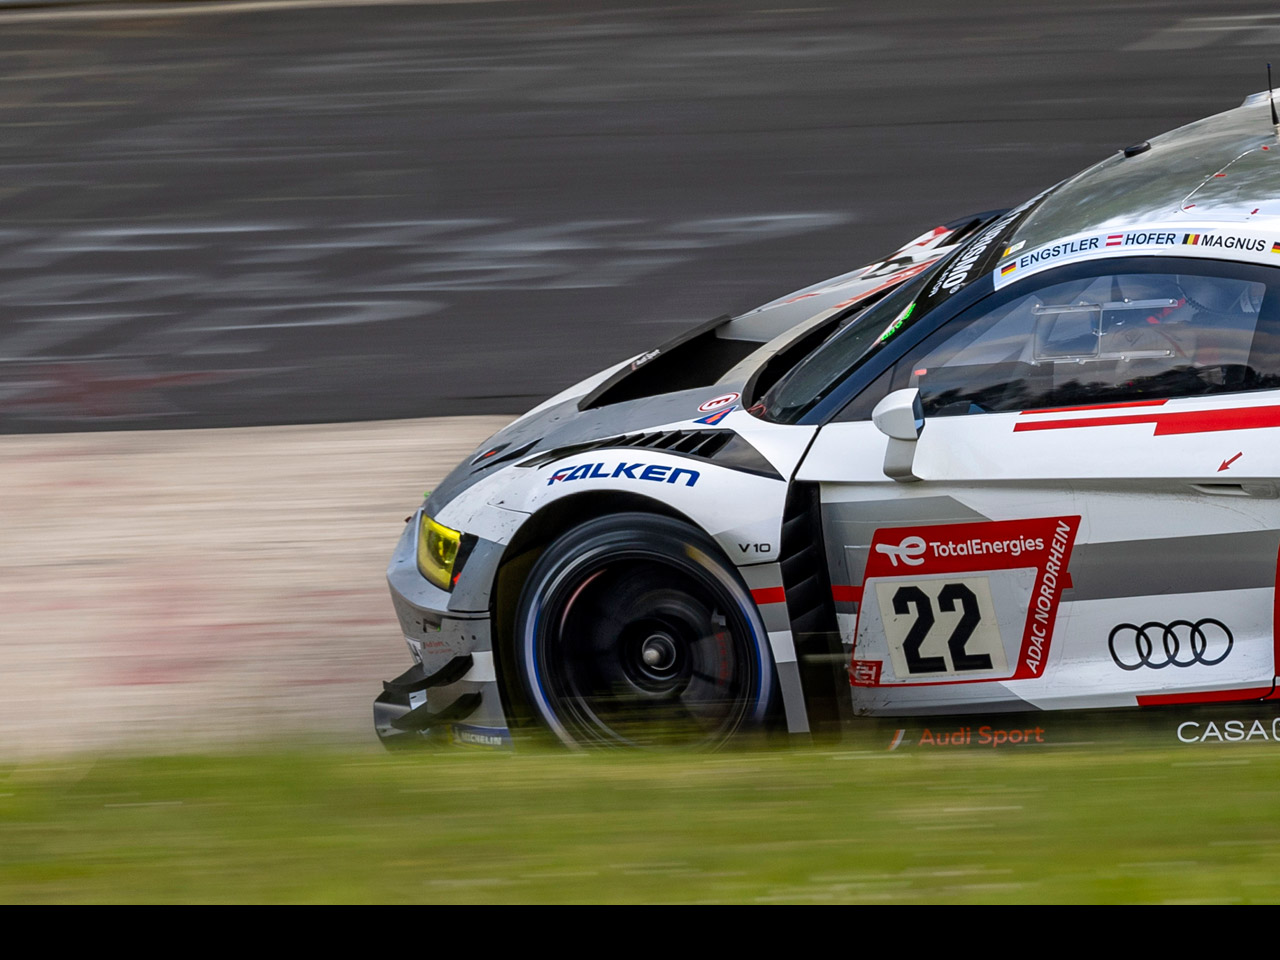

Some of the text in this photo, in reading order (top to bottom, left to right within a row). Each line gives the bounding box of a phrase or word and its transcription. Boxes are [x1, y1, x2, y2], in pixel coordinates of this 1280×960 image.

[1020, 237, 1099, 268] ENGSTLER
[1125, 233, 1176, 245] HOFER
[1201, 234, 1266, 252] MAGNUS
[547, 462, 701, 487] FALKEN
[929, 536, 1044, 557] TotalEnergies
[1026, 520, 1071, 674] ADAC NORDRHEIN
[892, 583, 993, 674] 22
[918, 726, 1045, 747] Audi Sport
[1177, 720, 1269, 743] CASA
